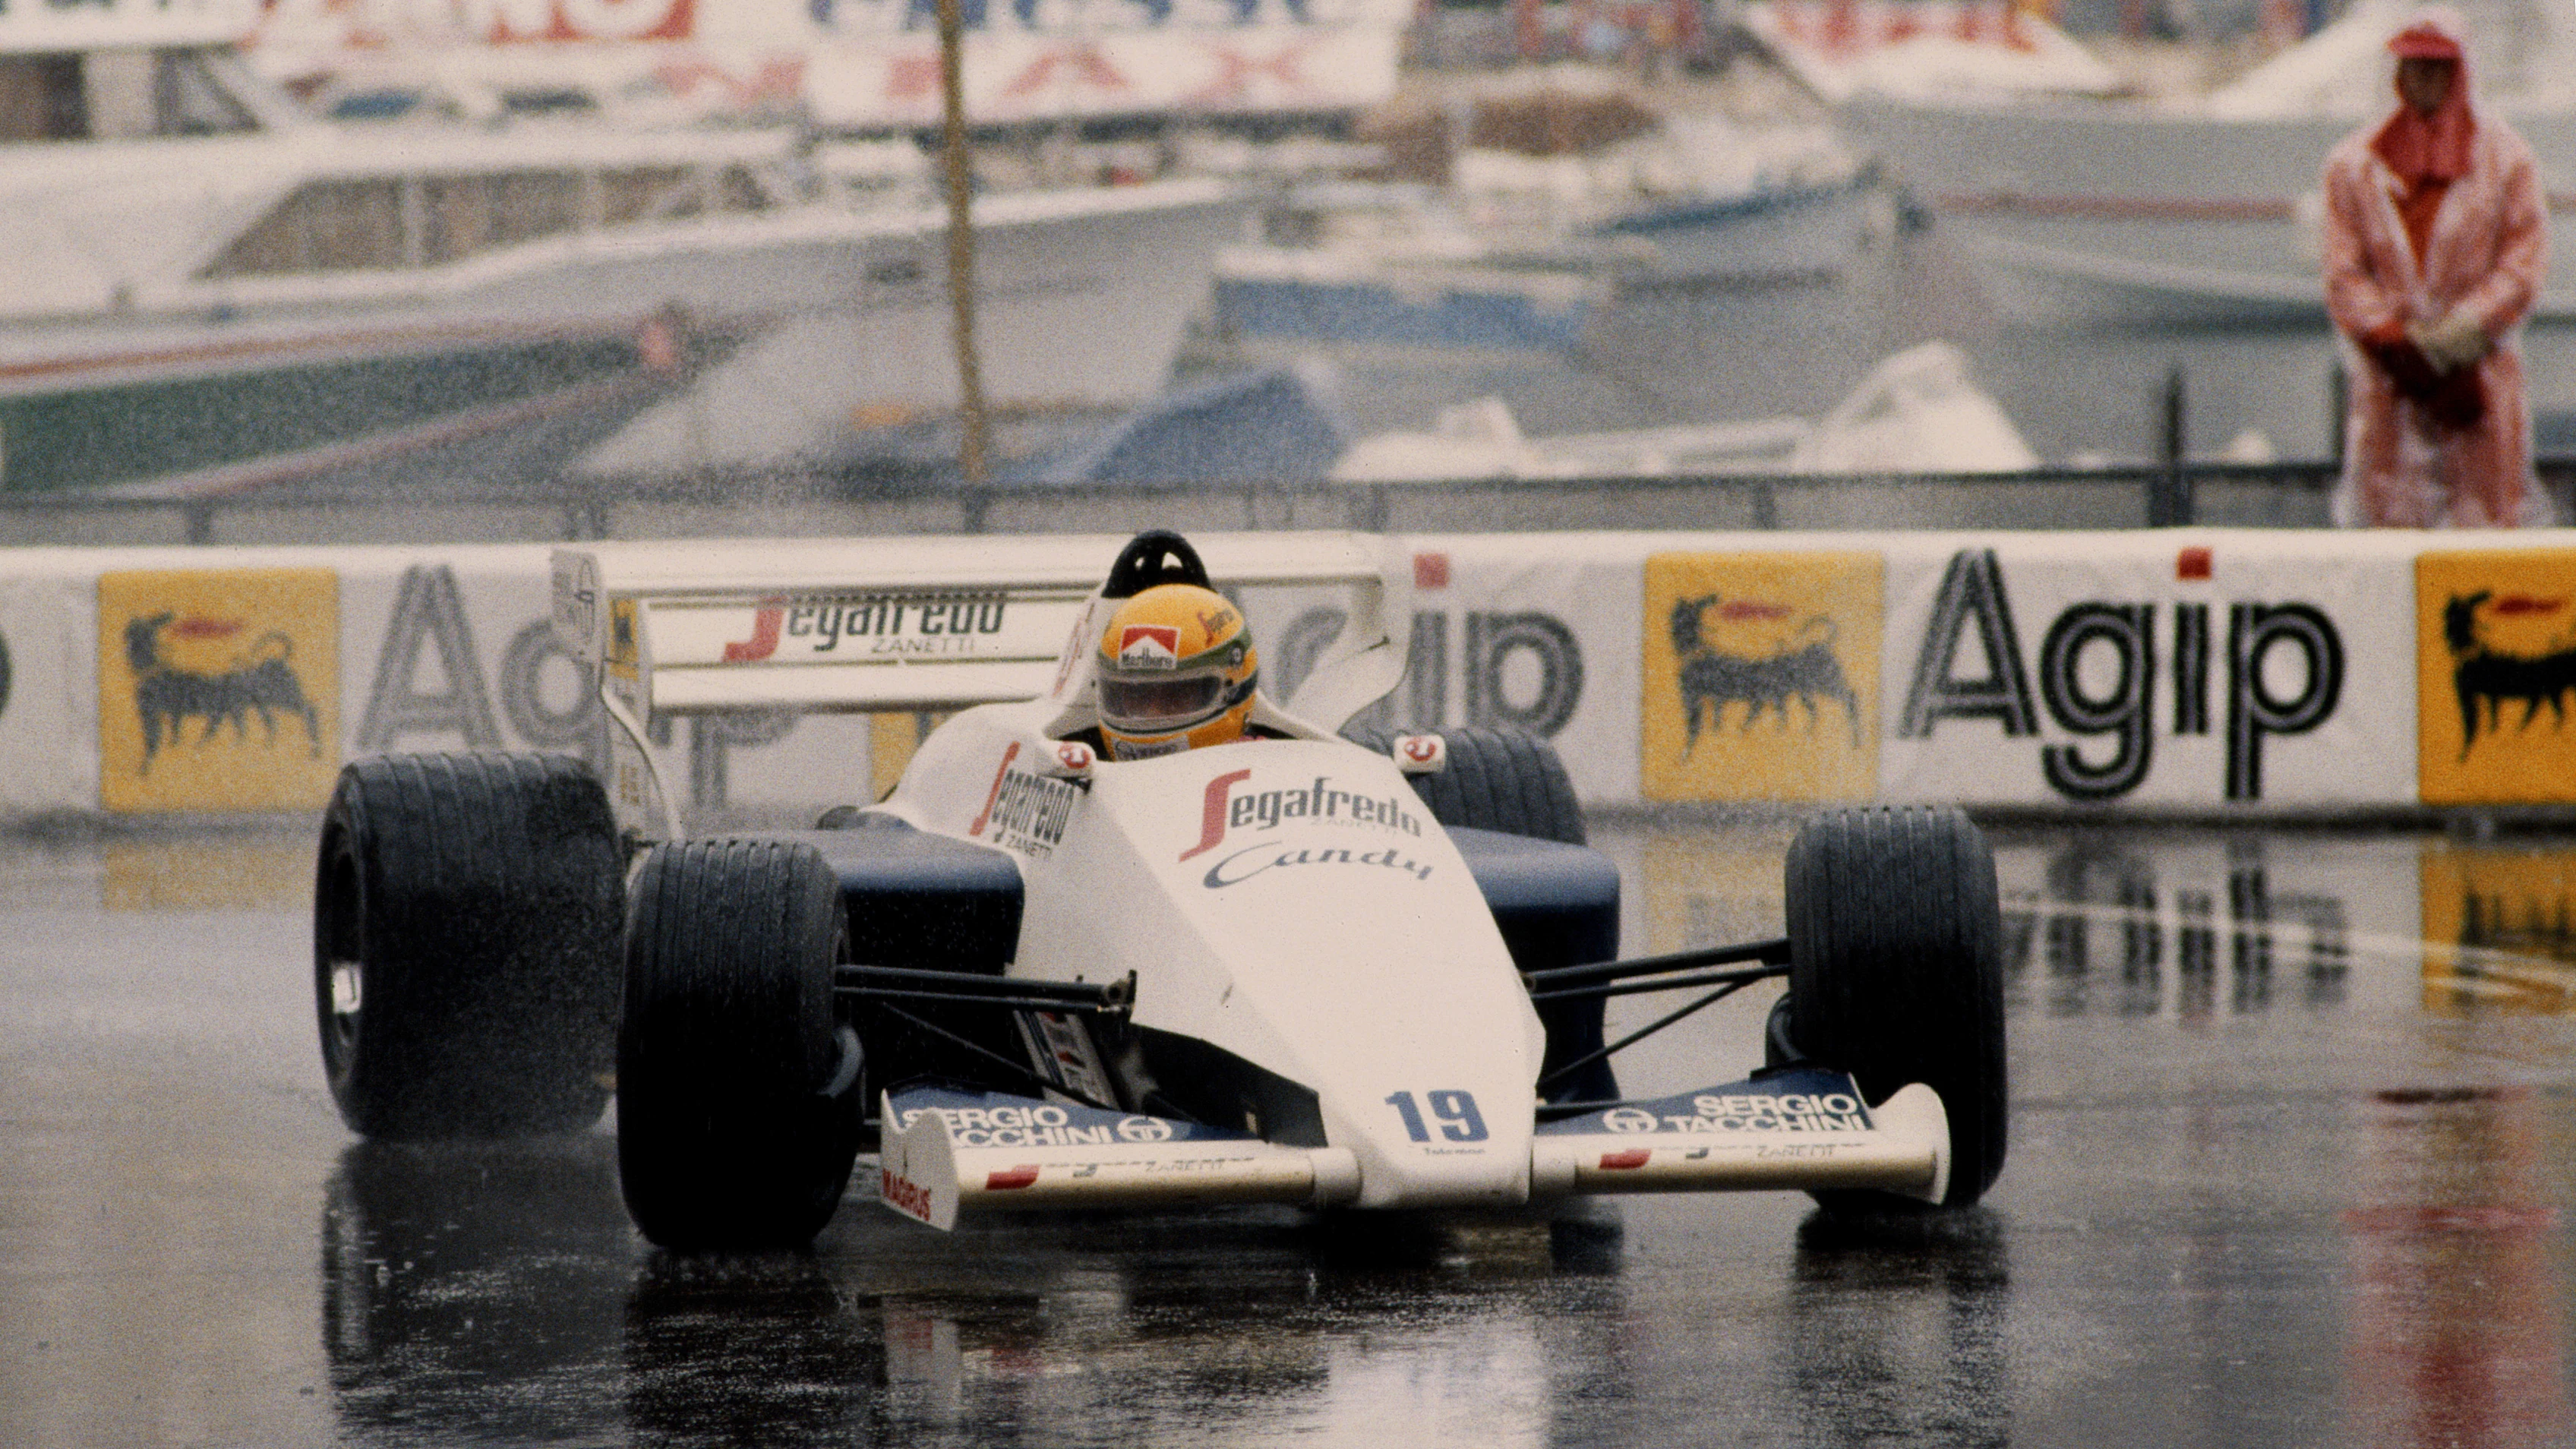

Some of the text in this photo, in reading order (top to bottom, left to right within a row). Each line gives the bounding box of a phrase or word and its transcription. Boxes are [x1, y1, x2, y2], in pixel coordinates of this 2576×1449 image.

[871, 636, 976, 653] ZANETTI
[1122, 647, 1173, 667] Marlboro
[1894, 548, 2345, 800] Agip
[969, 741, 1075, 845] Segafredo
[1178, 768, 1421, 863] Segafredo
[1203, 839, 1433, 889] Candy
[1384, 1090, 1489, 1142] 19
[1665, 1114, 1868, 1133] TACCHINI
[1694, 1094, 1858, 1116] SERGIO
